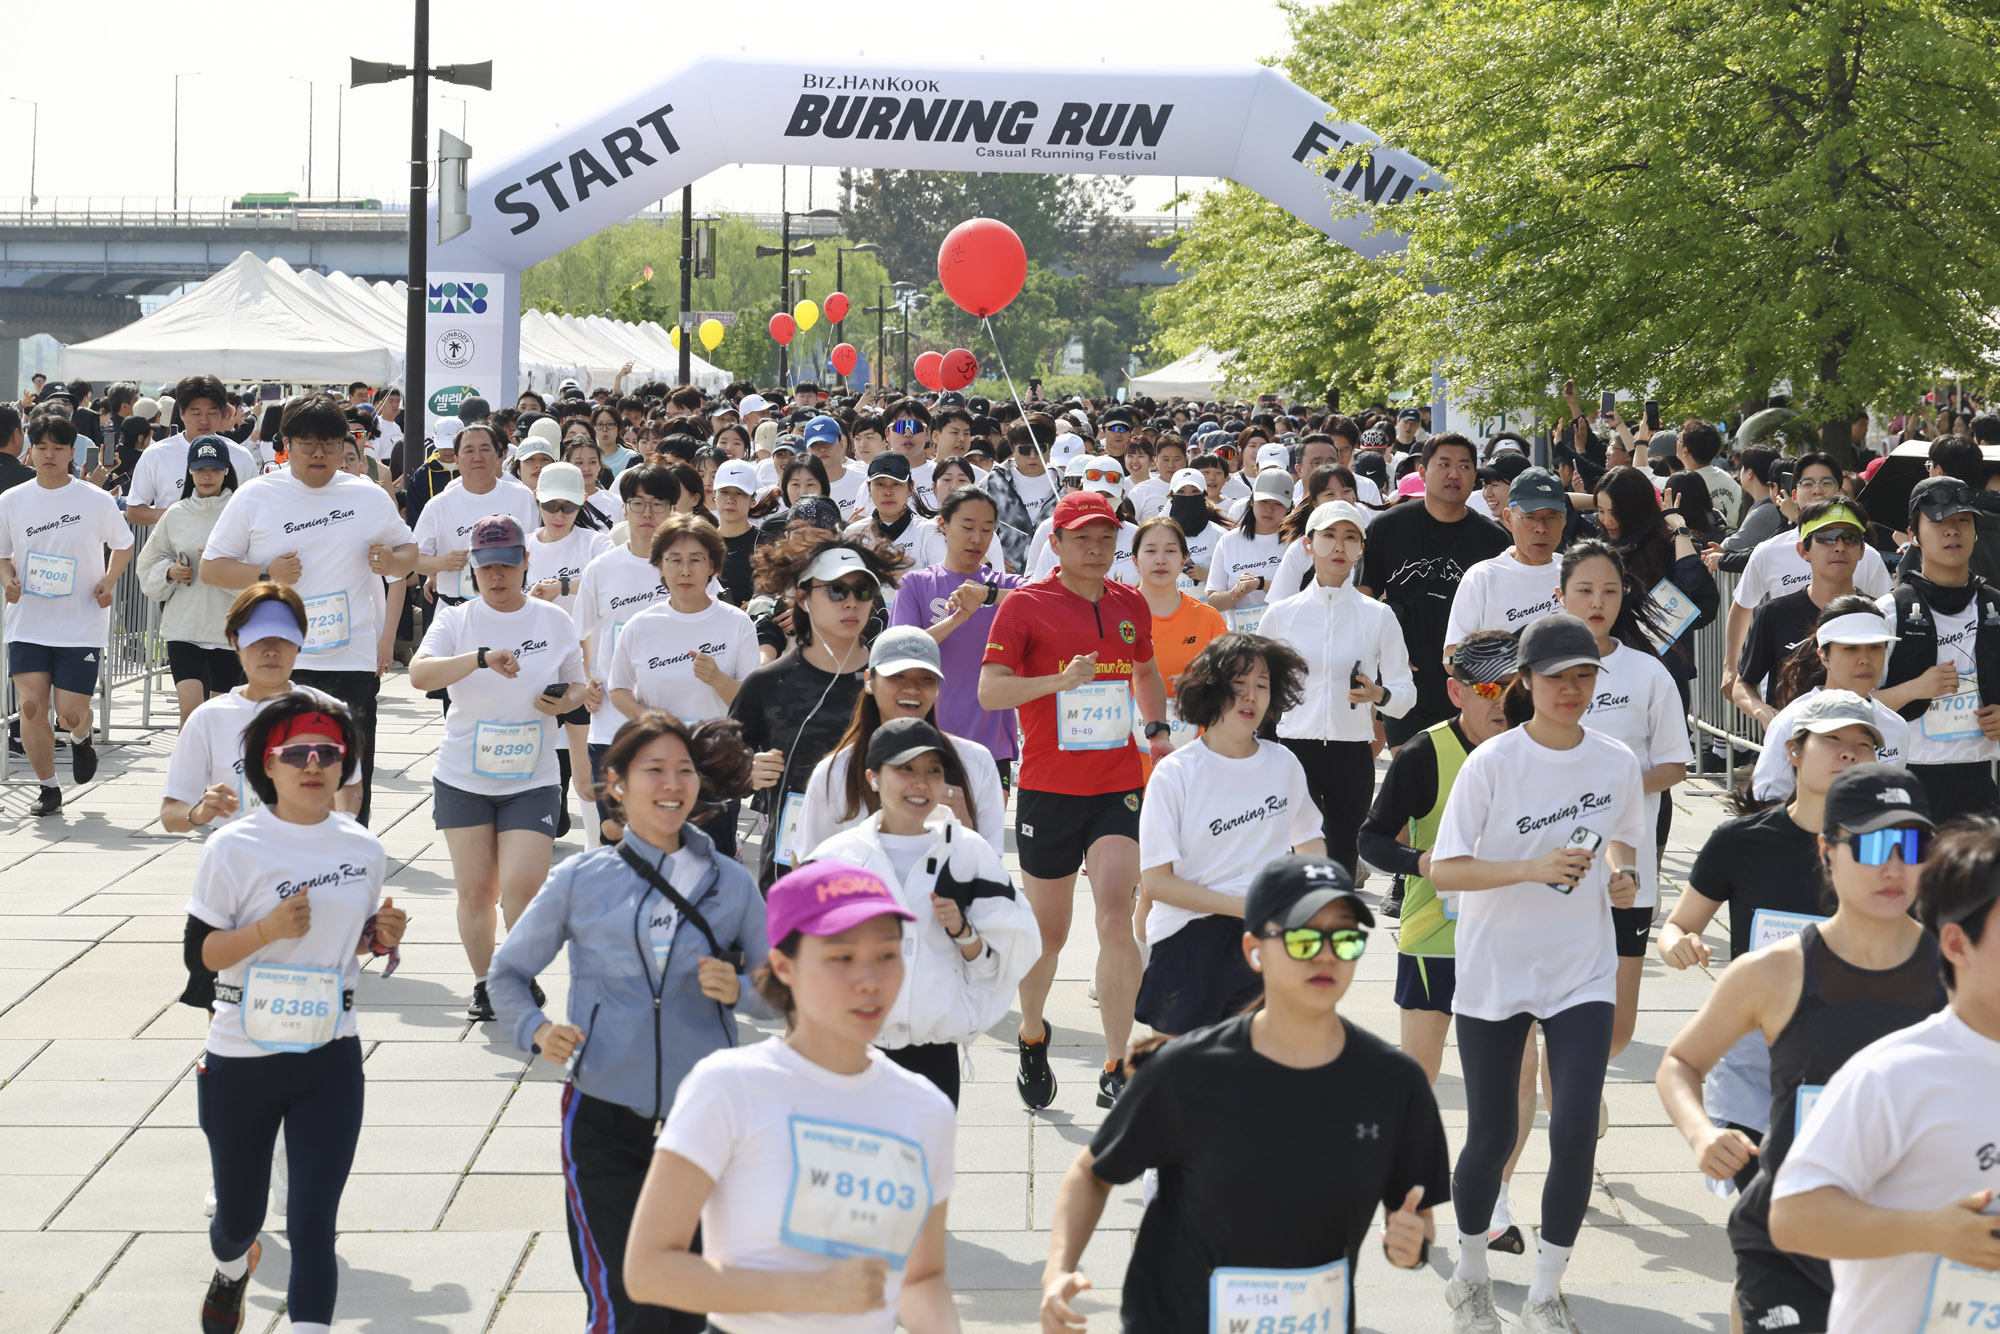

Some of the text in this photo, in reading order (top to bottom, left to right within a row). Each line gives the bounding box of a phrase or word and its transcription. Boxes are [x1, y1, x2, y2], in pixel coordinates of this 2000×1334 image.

[784, 94, 1174, 147] BURNING RUN
[975, 146, 1156, 161] Casual Running Festival
[494, 103, 680, 236] START
[1292, 120, 1436, 206] FINI
[441, 331, 470, 344] SUNBODY
[442, 357, 468, 367] TANNING
[957, 355, 978, 381] 35
[26, 514, 81, 537] Burning Run
[284, 508, 355, 534] Burning Run
[1190, 545, 1208, 555] Run
[558, 567, 581, 578] Run
[1232, 559, 1268, 573] Burning
[39, 570, 68, 582] 7008
[1782, 573, 1812, 586] Burni
[609, 593, 654, 610] Burning
[1506, 600, 1552, 622] Burning
[308, 612, 344, 629] 7234
[522, 639, 549, 653] Run
[1937, 632, 1963, 647] ning
[699, 643, 727, 654] Run
[1596, 692, 1630, 706] Run
[1943, 696, 1980, 711] 707
[1067, 706, 1122, 721] M 7411
[1071, 727, 1093, 735] B-49
[481, 743, 534, 757] W 8390
[1209, 795, 1288, 836] Burning Run
[1516, 804, 1580, 834] Burning
[1579, 792, 1612, 812] Run
[276, 863, 368, 899] Burning Run
[816, 876, 887, 904] HOKA
[1763, 919, 1803, 930] BURNING
[255, 971, 308, 983] BURNING RUN
[254, 998, 329, 1017] W 8386
[810, 1167, 915, 1211] W 8103
[1227, 1280, 1308, 1291] BURNING RUN
[1235, 1293, 1278, 1306] A-154
[1942, 1301, 1963, 1319] M
[1229, 1306, 1331, 1334] W 8541
